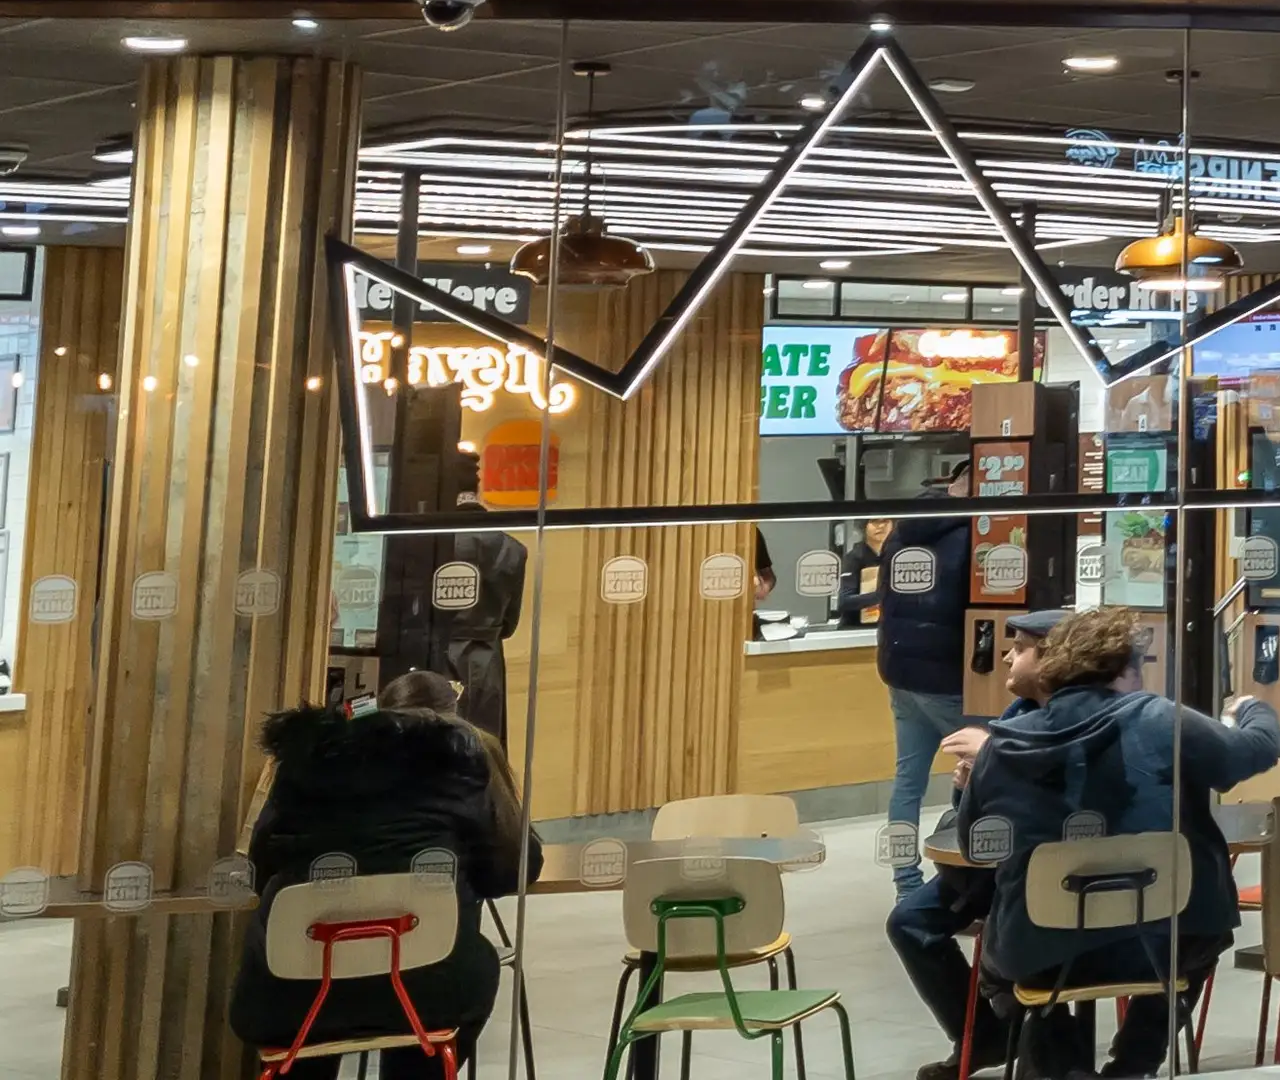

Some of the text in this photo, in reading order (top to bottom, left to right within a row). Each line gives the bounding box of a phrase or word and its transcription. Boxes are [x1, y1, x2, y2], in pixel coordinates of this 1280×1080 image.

[895, 562, 931, 571] BURGER
[1243, 559, 1274, 569] KING
[894, 571, 931, 583] KING
[987, 566, 1023, 580] KING
[1079, 566, 1104, 579] KIN
[437, 577, 475, 586] BURGER
[800, 573, 838, 586] KING
[436, 586, 476, 599] KING
[606, 580, 643, 593] KING
[879, 843, 916, 856] KING
[972, 839, 1010, 853] KING
